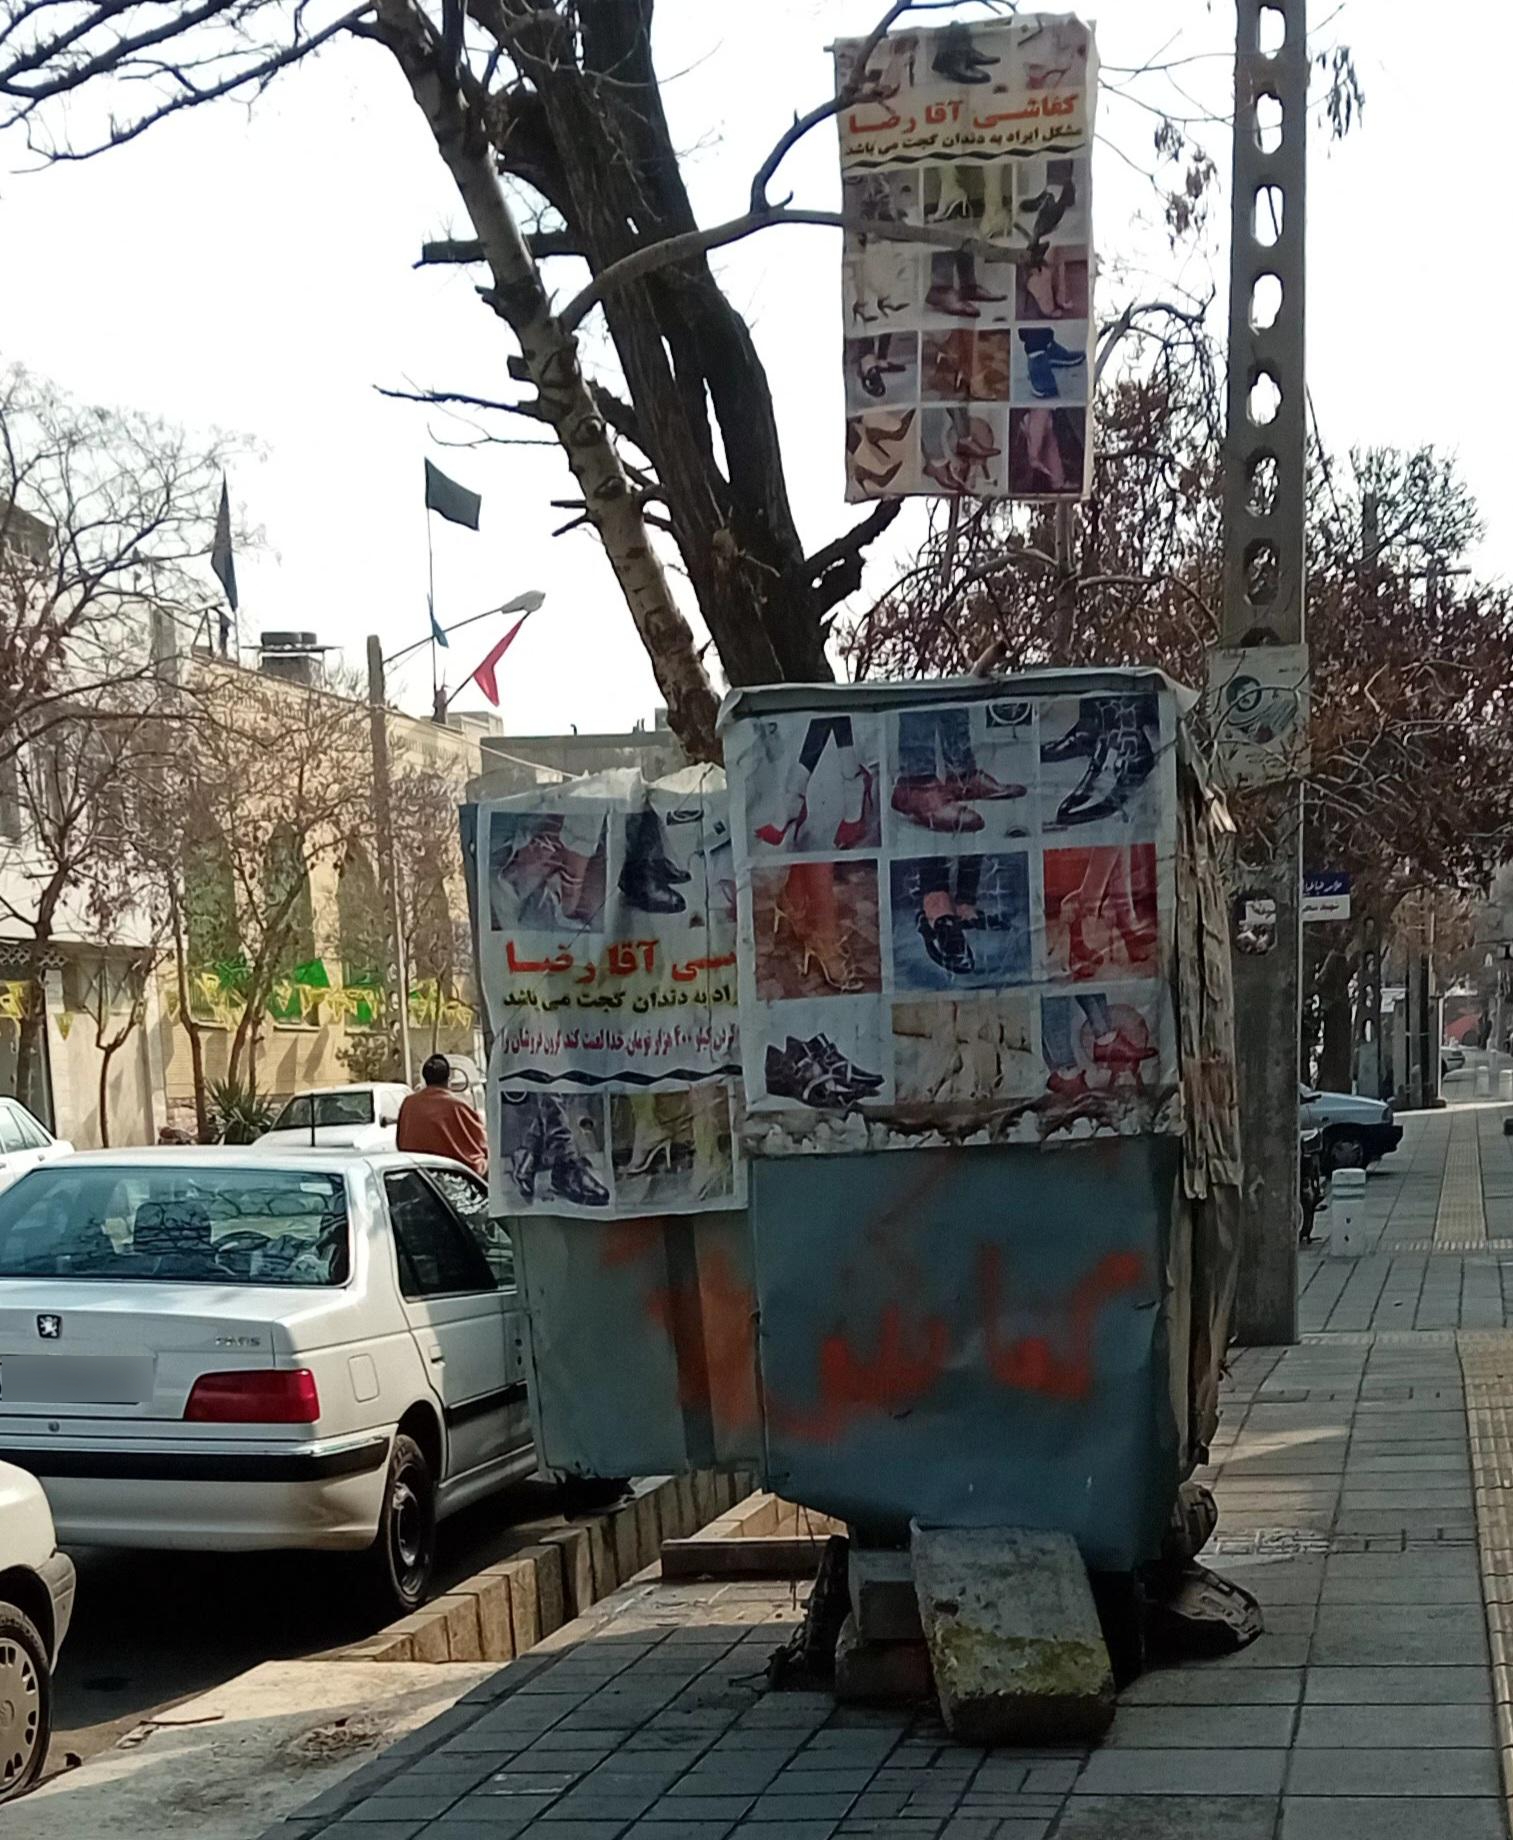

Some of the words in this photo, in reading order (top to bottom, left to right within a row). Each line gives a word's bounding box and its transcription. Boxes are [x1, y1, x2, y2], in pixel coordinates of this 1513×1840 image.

[924, 99, 964, 126] آقا
[972, 93, 1079, 129] کفاشی
[878, 141, 899, 156] می
[942, 131, 986, 148] دندان
[988, 135, 1004, 147] به
[505, 939, 597, 984] رضا
[606, 939, 660, 977] آقا
[503, 989, 540, 1010] باشد
[542, 995, 571, 1012] می
[632, 990, 690, 1013] دندان
